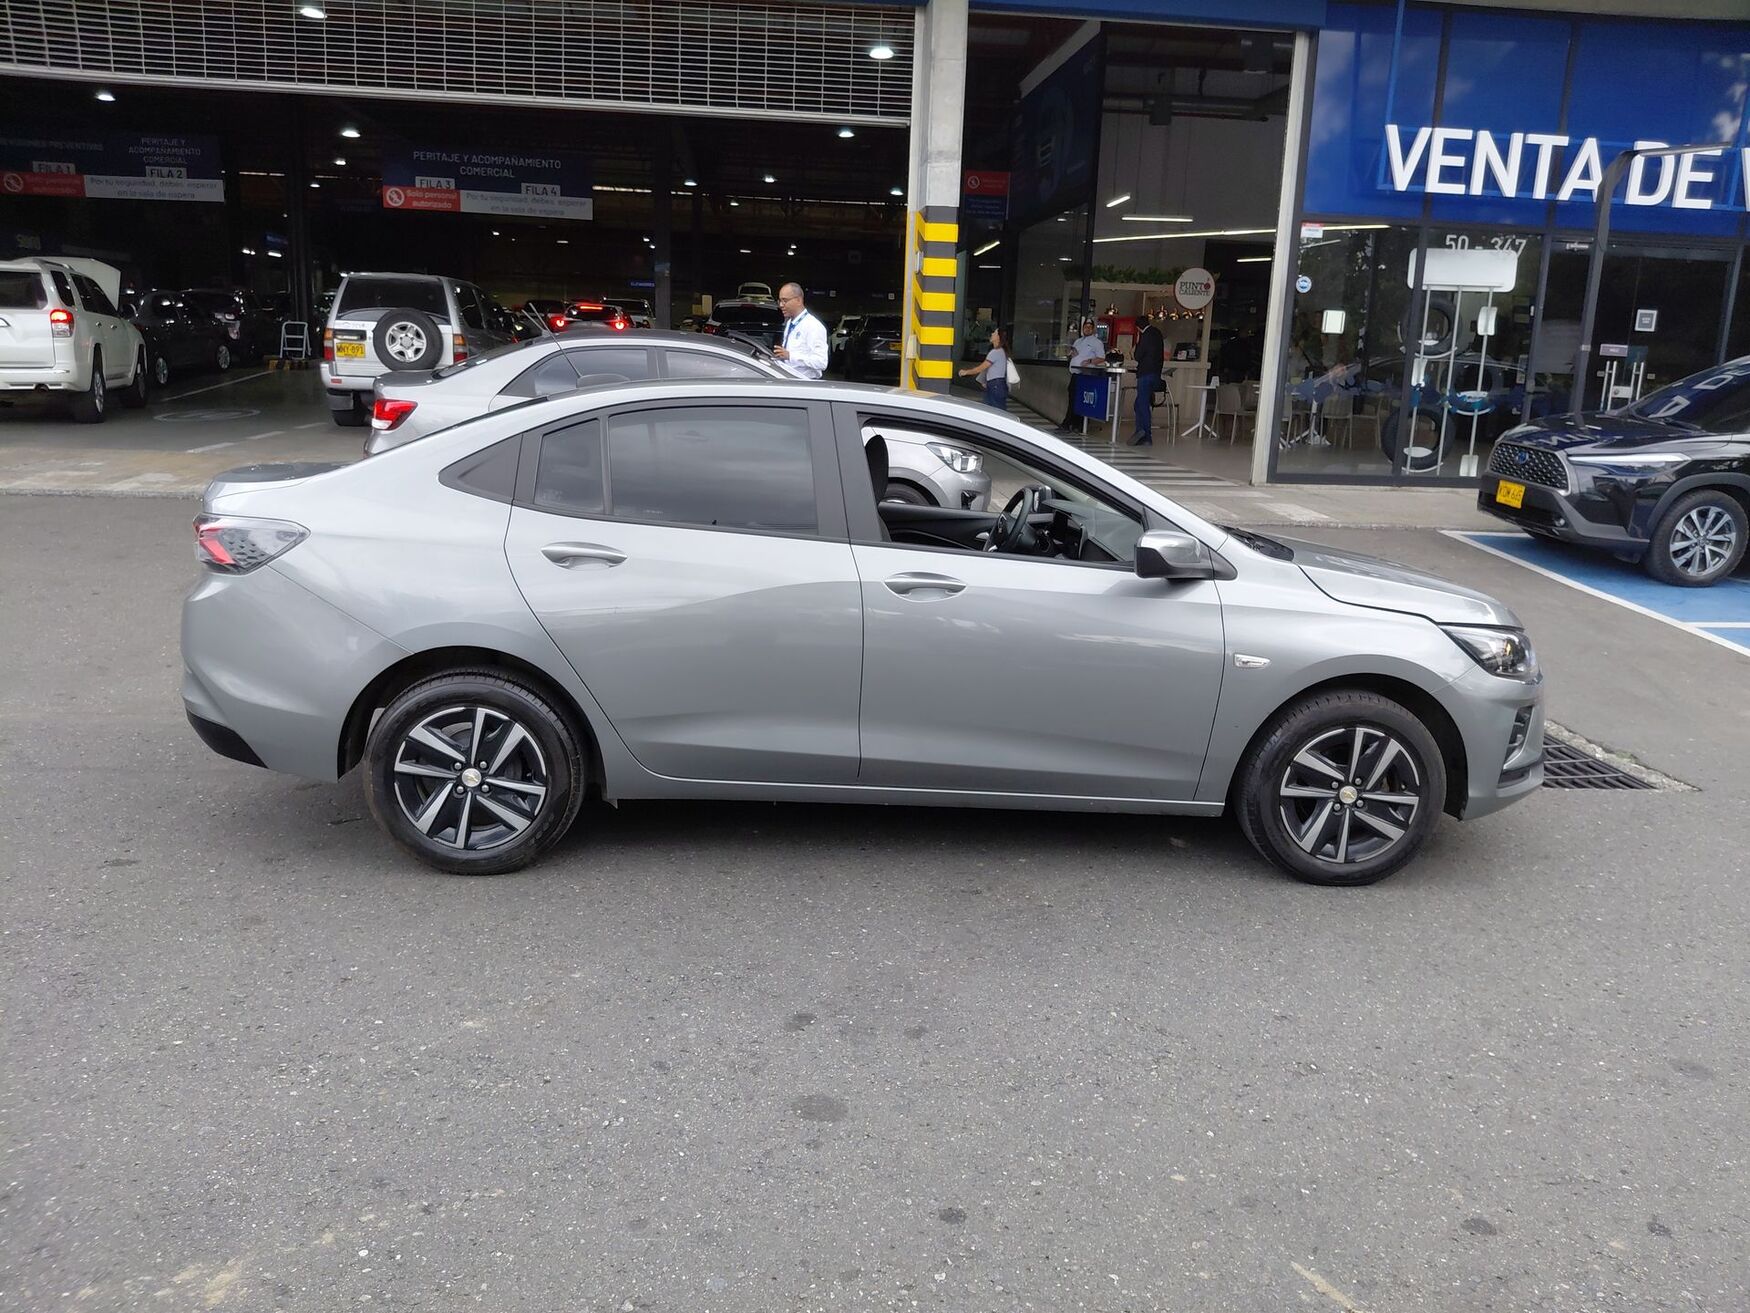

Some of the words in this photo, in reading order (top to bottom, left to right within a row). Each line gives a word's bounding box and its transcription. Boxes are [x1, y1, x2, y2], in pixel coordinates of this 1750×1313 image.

[413, 151, 461, 163] PERITAJE
[463, 154, 469, 163] Y
[459, 166, 516, 178] COMERCIAL
[1384, 124, 1604, 203] VENTA
[1624, 140, 1722, 209] DE
[150, 169, 174, 178] FILA
[176, 169, 183, 179] 2
[420, 178, 444, 189] FILA
[445, 180, 451, 189] 3
[526, 185, 547, 196] FILA
[550, 187, 557, 197] 4
[1445, 234, 1469, 250] 50
[1490, 236, 1527, 258] 347
